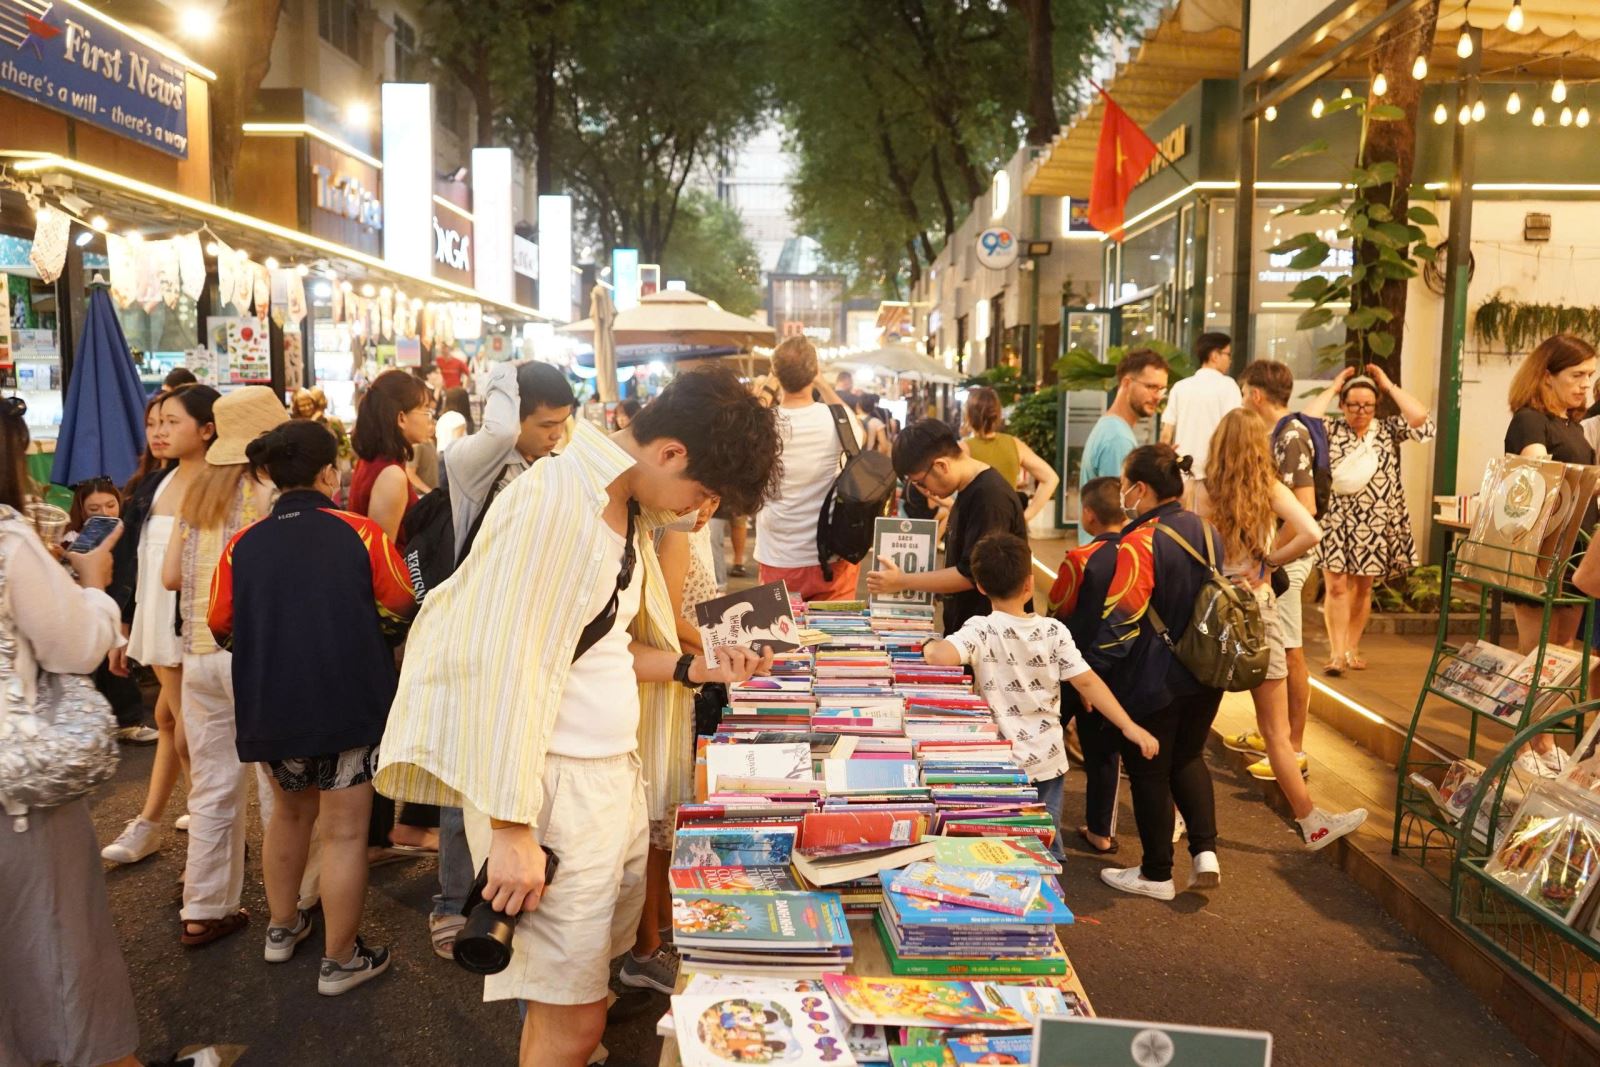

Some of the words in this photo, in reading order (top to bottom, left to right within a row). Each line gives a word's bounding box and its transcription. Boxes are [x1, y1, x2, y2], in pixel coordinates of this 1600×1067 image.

[1, 60, 54, 97] there's
[58, 86, 67, 102] a
[71, 90, 97, 114] will
[111, 105, 152, 137] there's
[154, 126, 163, 142] a
[164, 131, 188, 153] way
[64, 18, 122, 83] First
[128, 51, 184, 111] News
